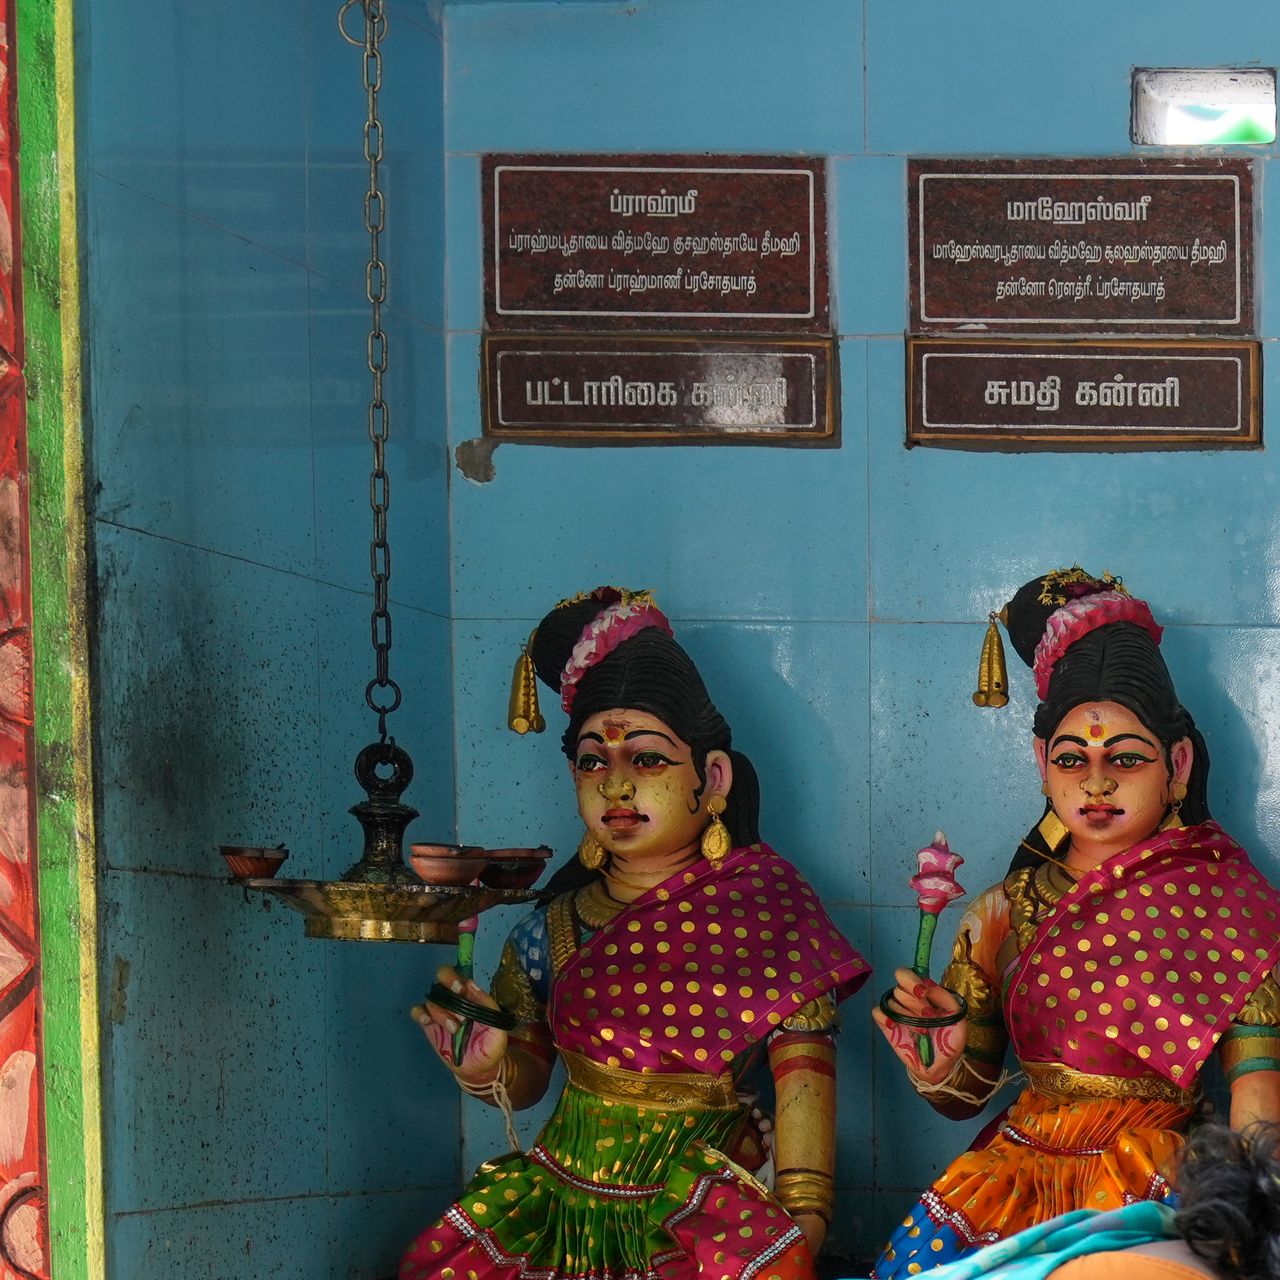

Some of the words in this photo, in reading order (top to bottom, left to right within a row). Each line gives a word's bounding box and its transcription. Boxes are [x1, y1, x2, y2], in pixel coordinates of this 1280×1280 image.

[609, 187, 699, 218] ப்ராஹ்மீ
[1006, 194, 1153, 225] மாஹேஸ்வரீ
[508, 229, 609, 257] ப்ராஹ்மபூதாயை
[611, 229, 670, 257] வித்மஹே
[672, 231, 758, 259] குசஹஸ்தாயே
[760, 229, 801, 260] தீமஹி
[932, 239, 1047, 267] மாஹேஸ்வரபூதாயை
[1047, 238, 1103, 267] வித்மஹே
[1190, 237, 1228, 267] தீமஹி
[553, 267, 605, 296] தன்னோ
[608, 267, 683, 296] ப்ராஹ்மாணீ
[684, 268, 757, 298] ப்ரசோதயாத்
[995, 275, 1046, 303] தன்னோ
[1096, 275, 1166, 304] ப்ரசோதயாத்
[525, 374, 678, 407] பட்டாரிகை
[691, 371, 788, 407] கன்னி
[984, 375, 1062, 412] சுமதி
[1074, 373, 1180, 408] கன்னி
